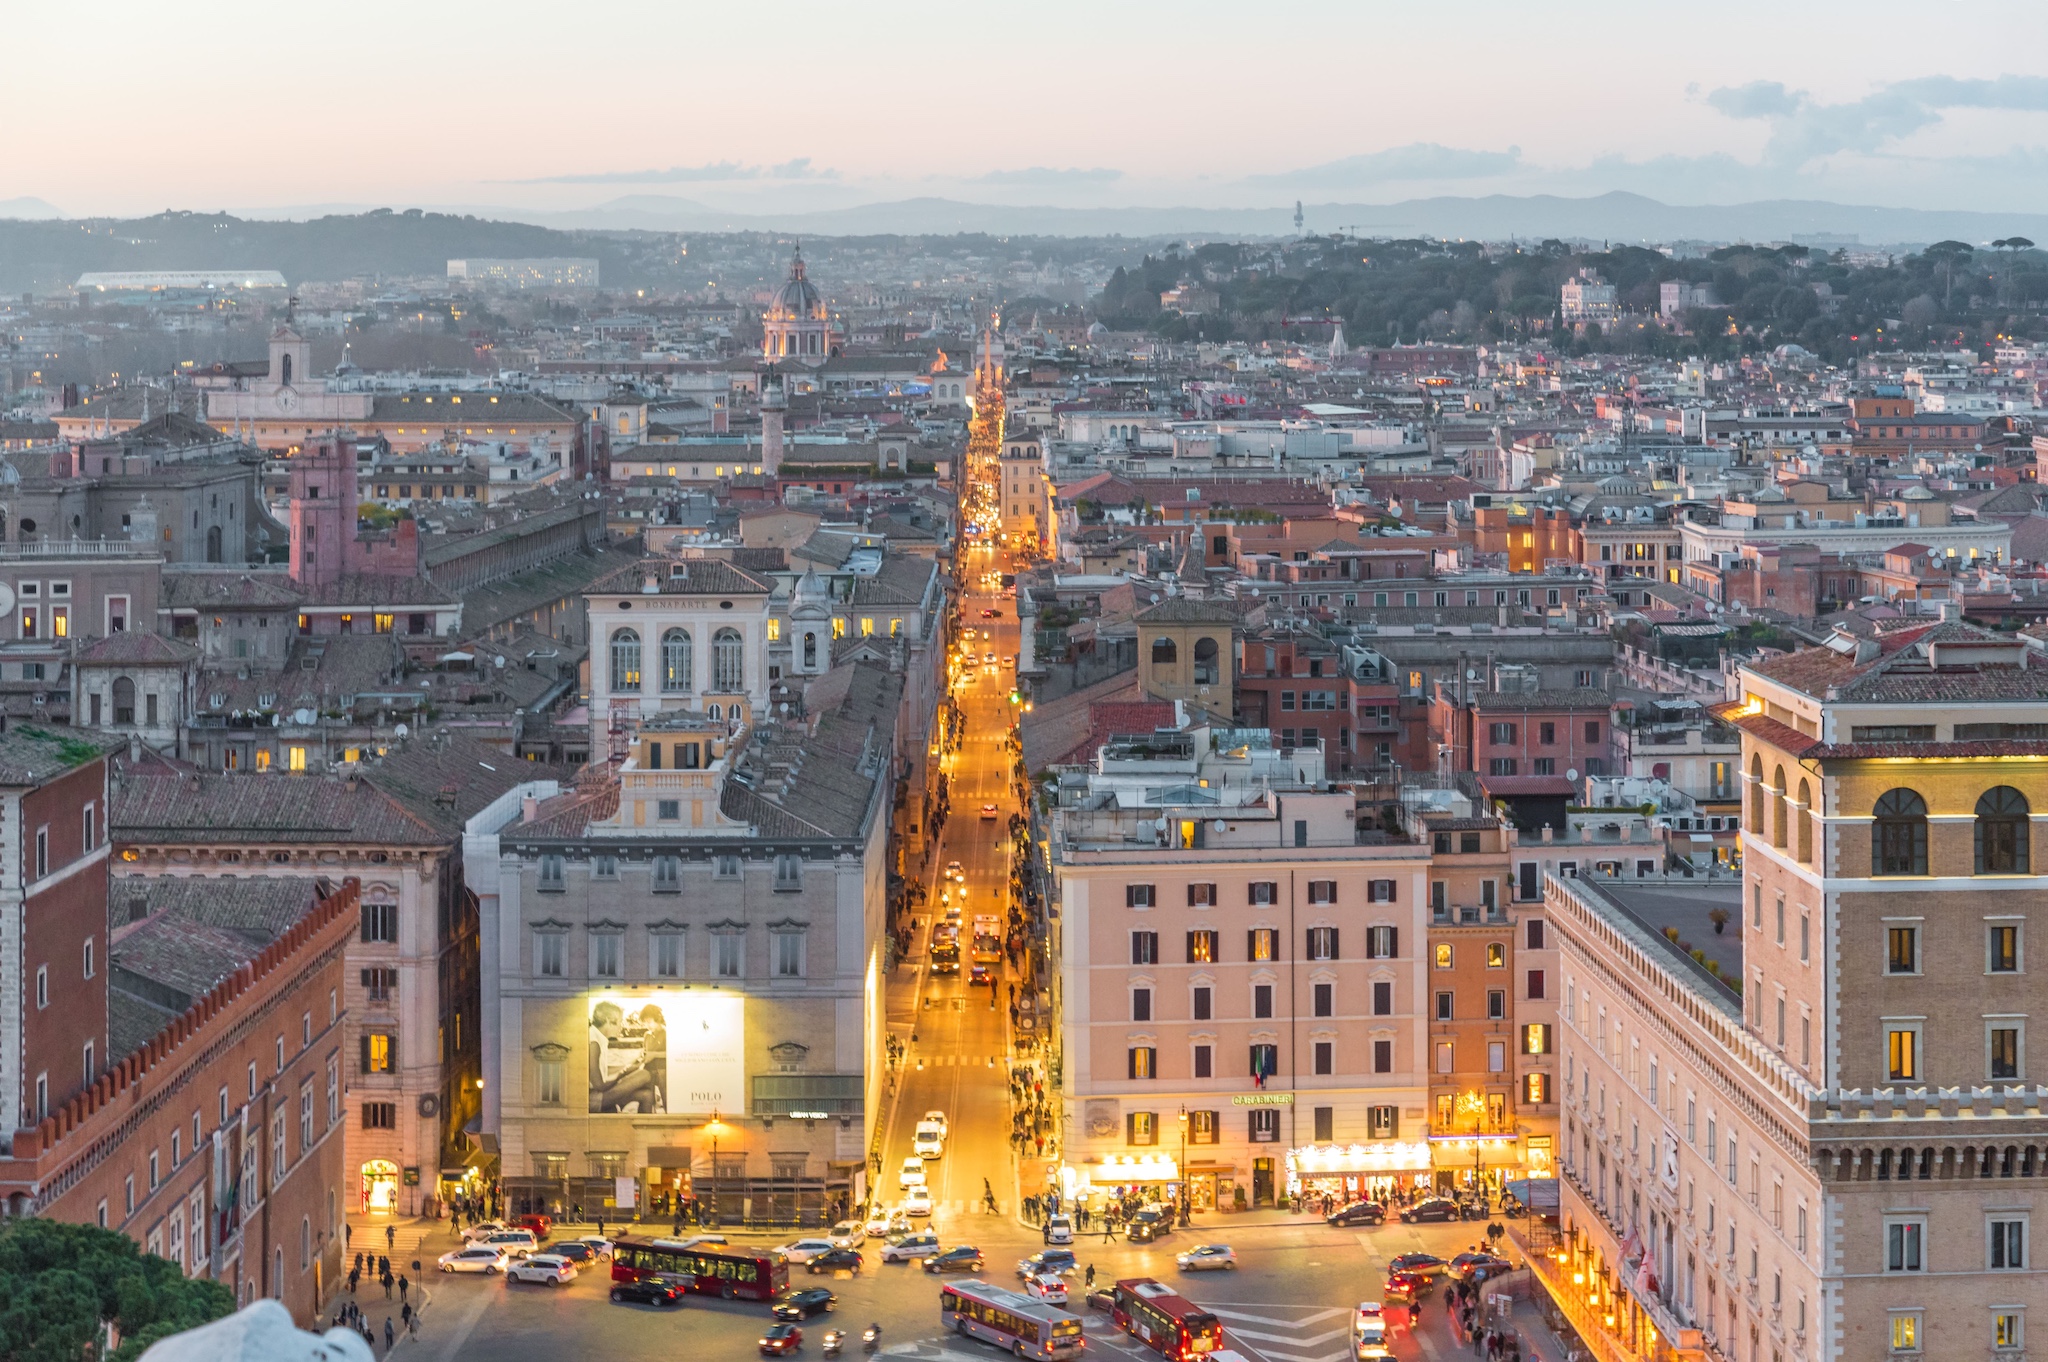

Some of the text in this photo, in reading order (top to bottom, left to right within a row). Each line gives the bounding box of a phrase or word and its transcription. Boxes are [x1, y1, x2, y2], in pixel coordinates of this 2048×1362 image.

[645, 600, 708, 609] BONAPARTE
[691, 1092, 722, 1101] POLO
[1232, 1094, 1294, 1105] CARABINIERI
